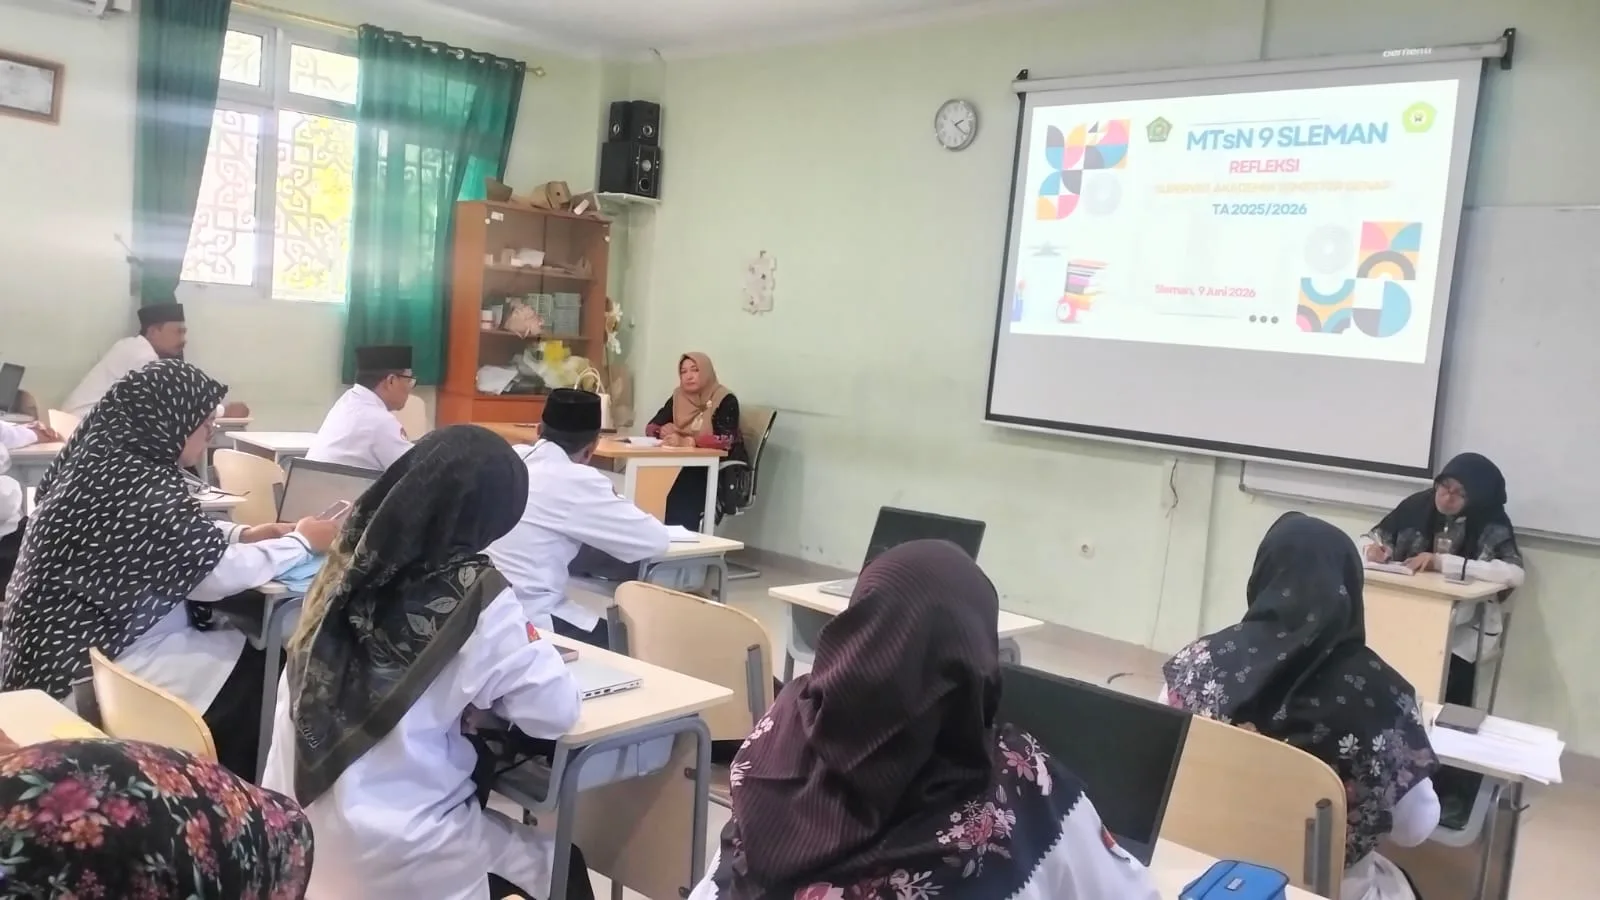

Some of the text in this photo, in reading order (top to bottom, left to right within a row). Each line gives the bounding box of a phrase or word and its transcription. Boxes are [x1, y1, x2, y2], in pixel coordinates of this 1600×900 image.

[1187, 121, 1389, 151] MTsN 9 SLEMAN
[1229, 158, 1300, 174] REFLEKSI
[1212, 203, 1307, 216] TA 2025/2026
[1198, 286, 1205, 296] 9
[1206, 286, 1228, 297] Juni
[1229, 287, 1256, 298] 2026
